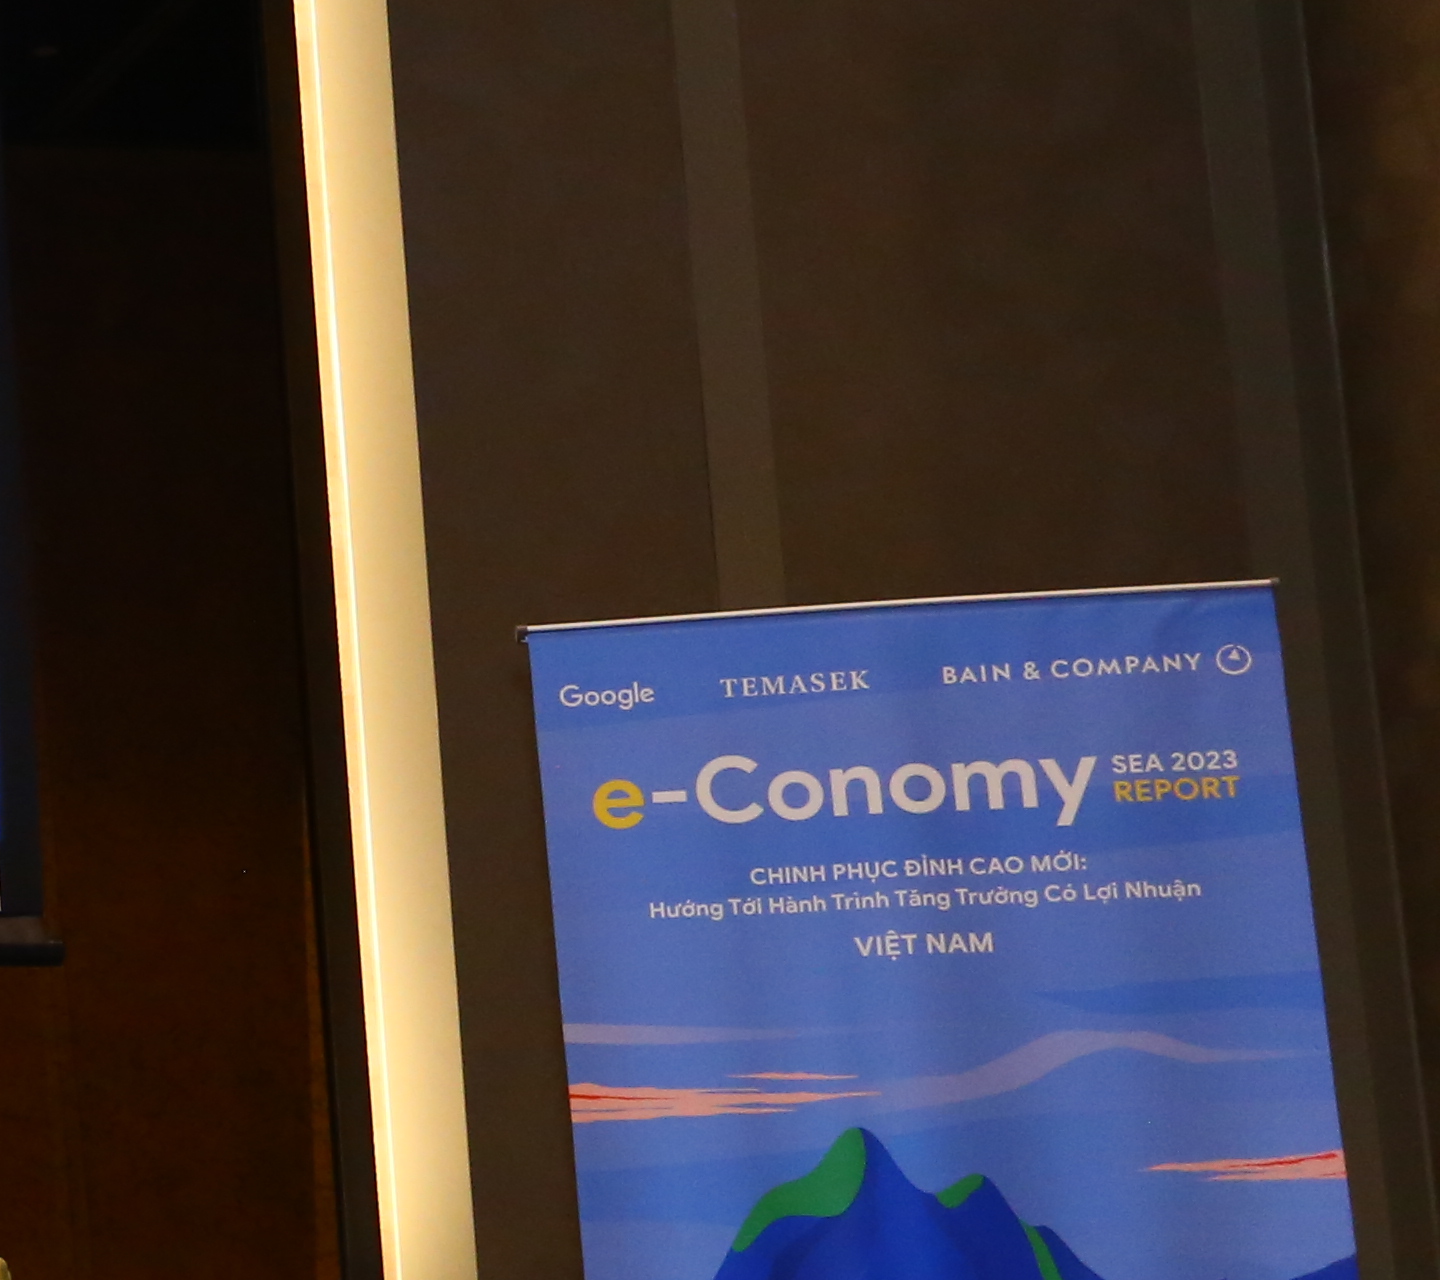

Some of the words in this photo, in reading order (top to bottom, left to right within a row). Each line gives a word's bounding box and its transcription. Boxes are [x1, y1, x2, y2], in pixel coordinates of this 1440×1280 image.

[719, 669, 871, 699] TEMASEK
[942, 661, 1012, 685] BAIN
[1022, 660, 1041, 681] &
[1050, 652, 1203, 679] COMPANY
[558, 681, 656, 710] Google
[1110, 753, 1165, 775] SEA
[1170, 749, 1240, 771] 2023
[592, 754, 1098, 829] e-Conomy
[1112, 775, 1241, 803] REPORT
[749, 864, 827, 886] CHINH
[832, 859, 899, 883] PHỤC
[969, 854, 1025, 876] CAO
[648, 899, 725, 921] Hướng
[727, 896, 762, 916] Tới
[768, 893, 827, 915] Hành
[893, 888, 952, 912] Tăng
[954, 885, 1040, 908] Trưởng
[1044, 882, 1077, 903] Có
[1083, 881, 1118, 905] Lợi
[1124, 879, 1203, 902] Nhuận
[852, 929, 918, 962] VIỆT
[925, 931, 995, 955] NAM
